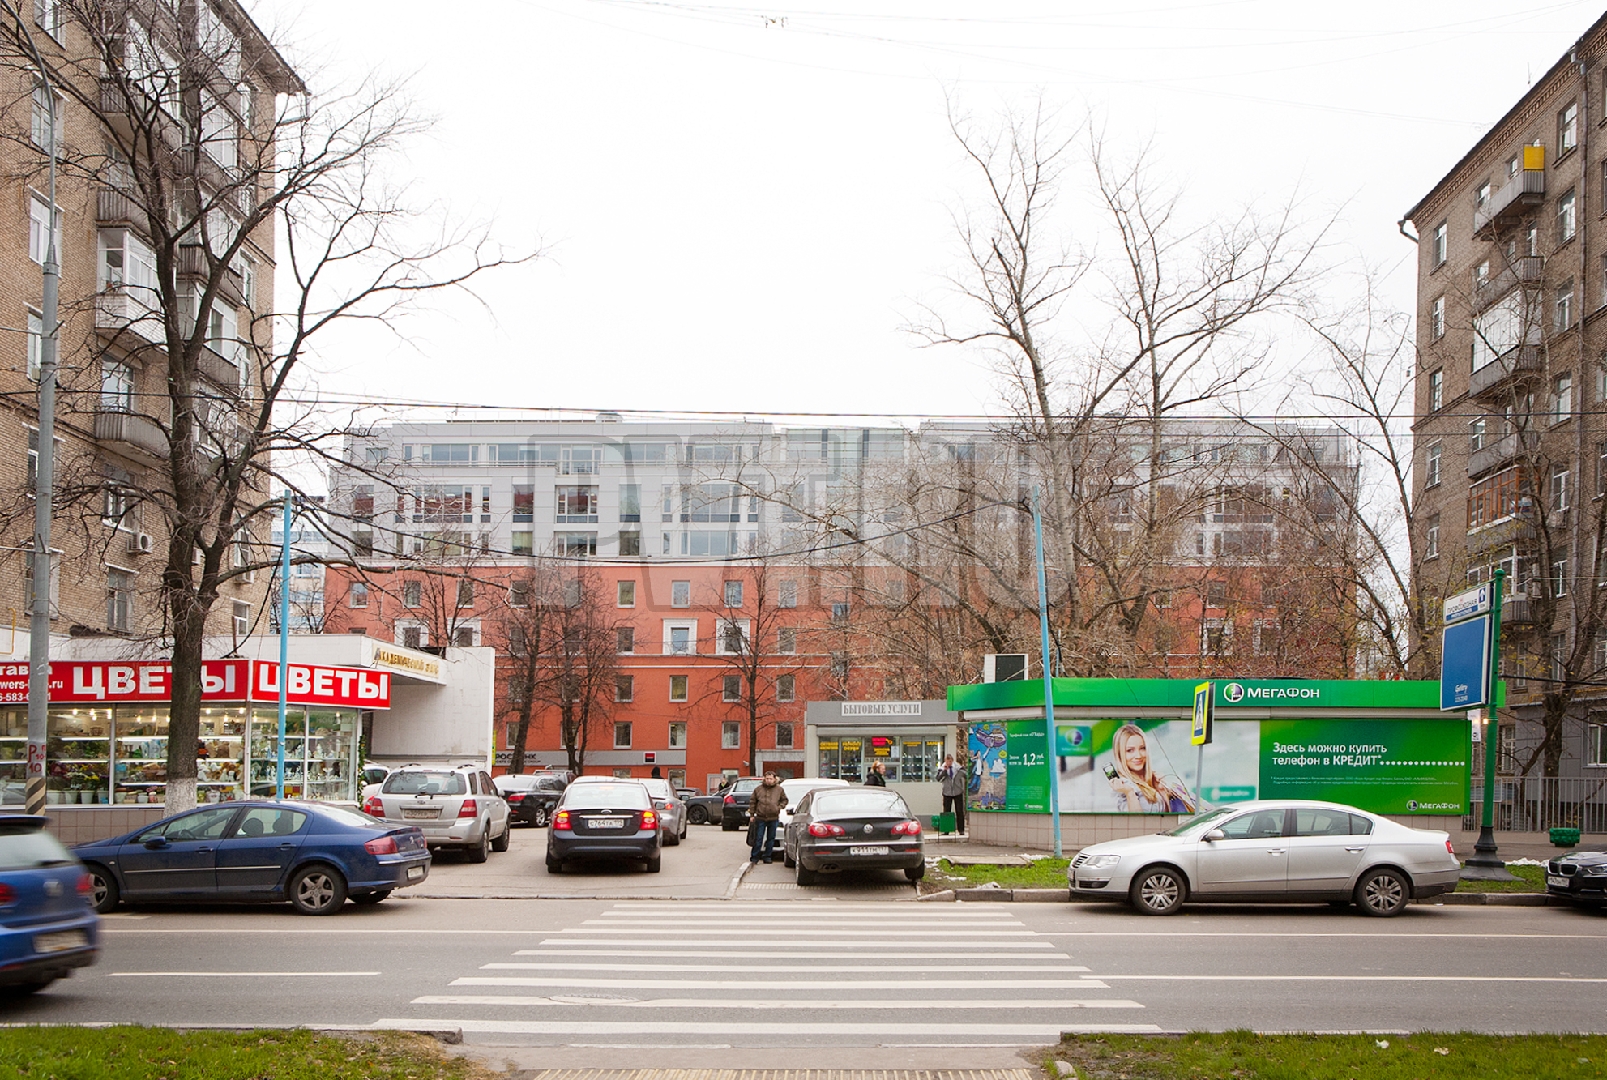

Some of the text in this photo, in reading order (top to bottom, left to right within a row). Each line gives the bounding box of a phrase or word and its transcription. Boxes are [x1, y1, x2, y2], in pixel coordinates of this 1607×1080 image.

[73, 664, 237, 699] ЦВЕЫ
[259, 663, 388, 700] ЦВЕТЫ
[844, 704, 919, 714] БЫТОВЫЕ УСЛУГИ
[1273, 742, 1387, 754] Здесь можно купить
[1023, 753, 1036, 766] 1,2
[1272, 755, 1320, 767] телефон
[1323, 757, 1330, 765] в
